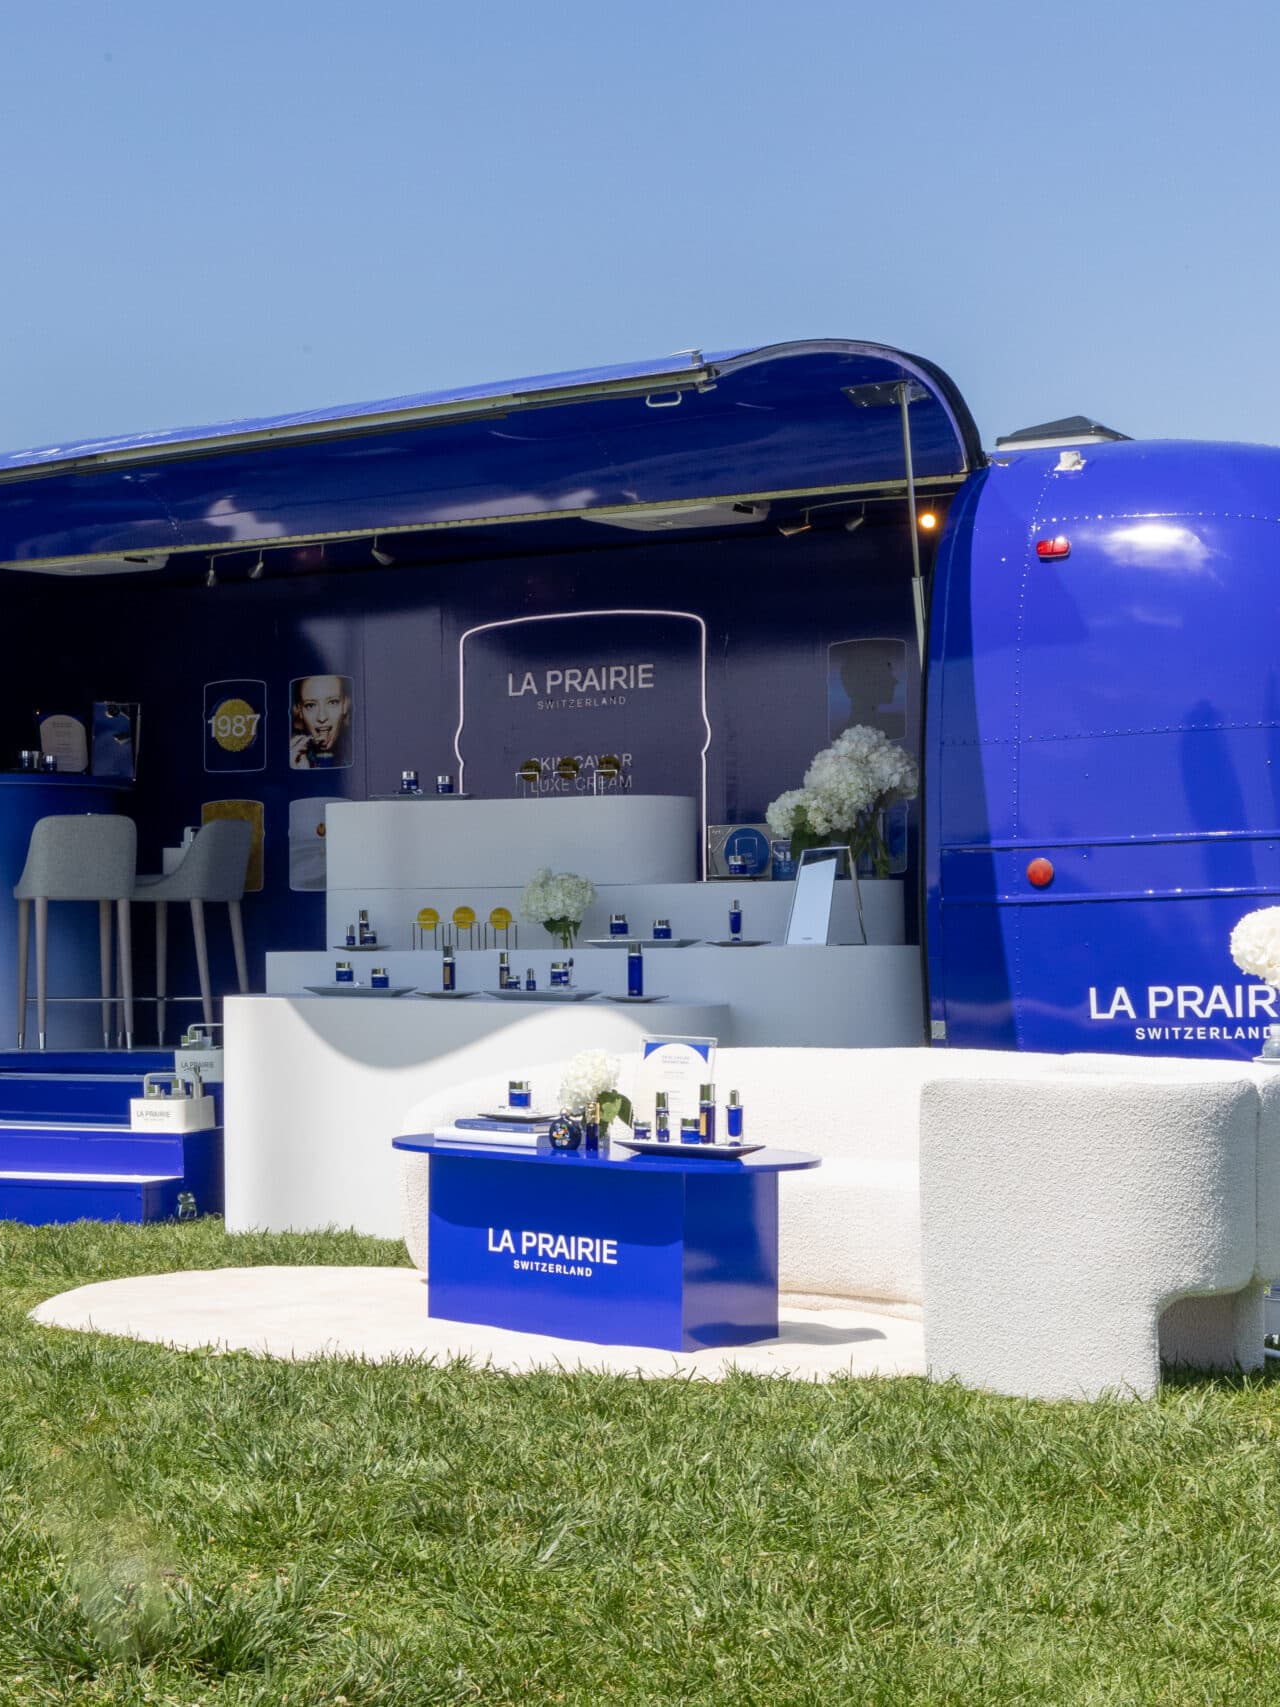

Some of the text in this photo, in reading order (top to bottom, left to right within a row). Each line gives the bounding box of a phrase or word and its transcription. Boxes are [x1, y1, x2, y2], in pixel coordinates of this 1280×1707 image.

[508, 664, 654, 697] LA PRAIRIE
[537, 696, 626, 710] SWITZERLAND
[207, 713, 260, 738] 1987
[1089, 986, 1137, 1020] LA
[488, 1227, 618, 1265] LA PRAIRIE
[513, 1259, 593, 1277] SWITZERLAND
